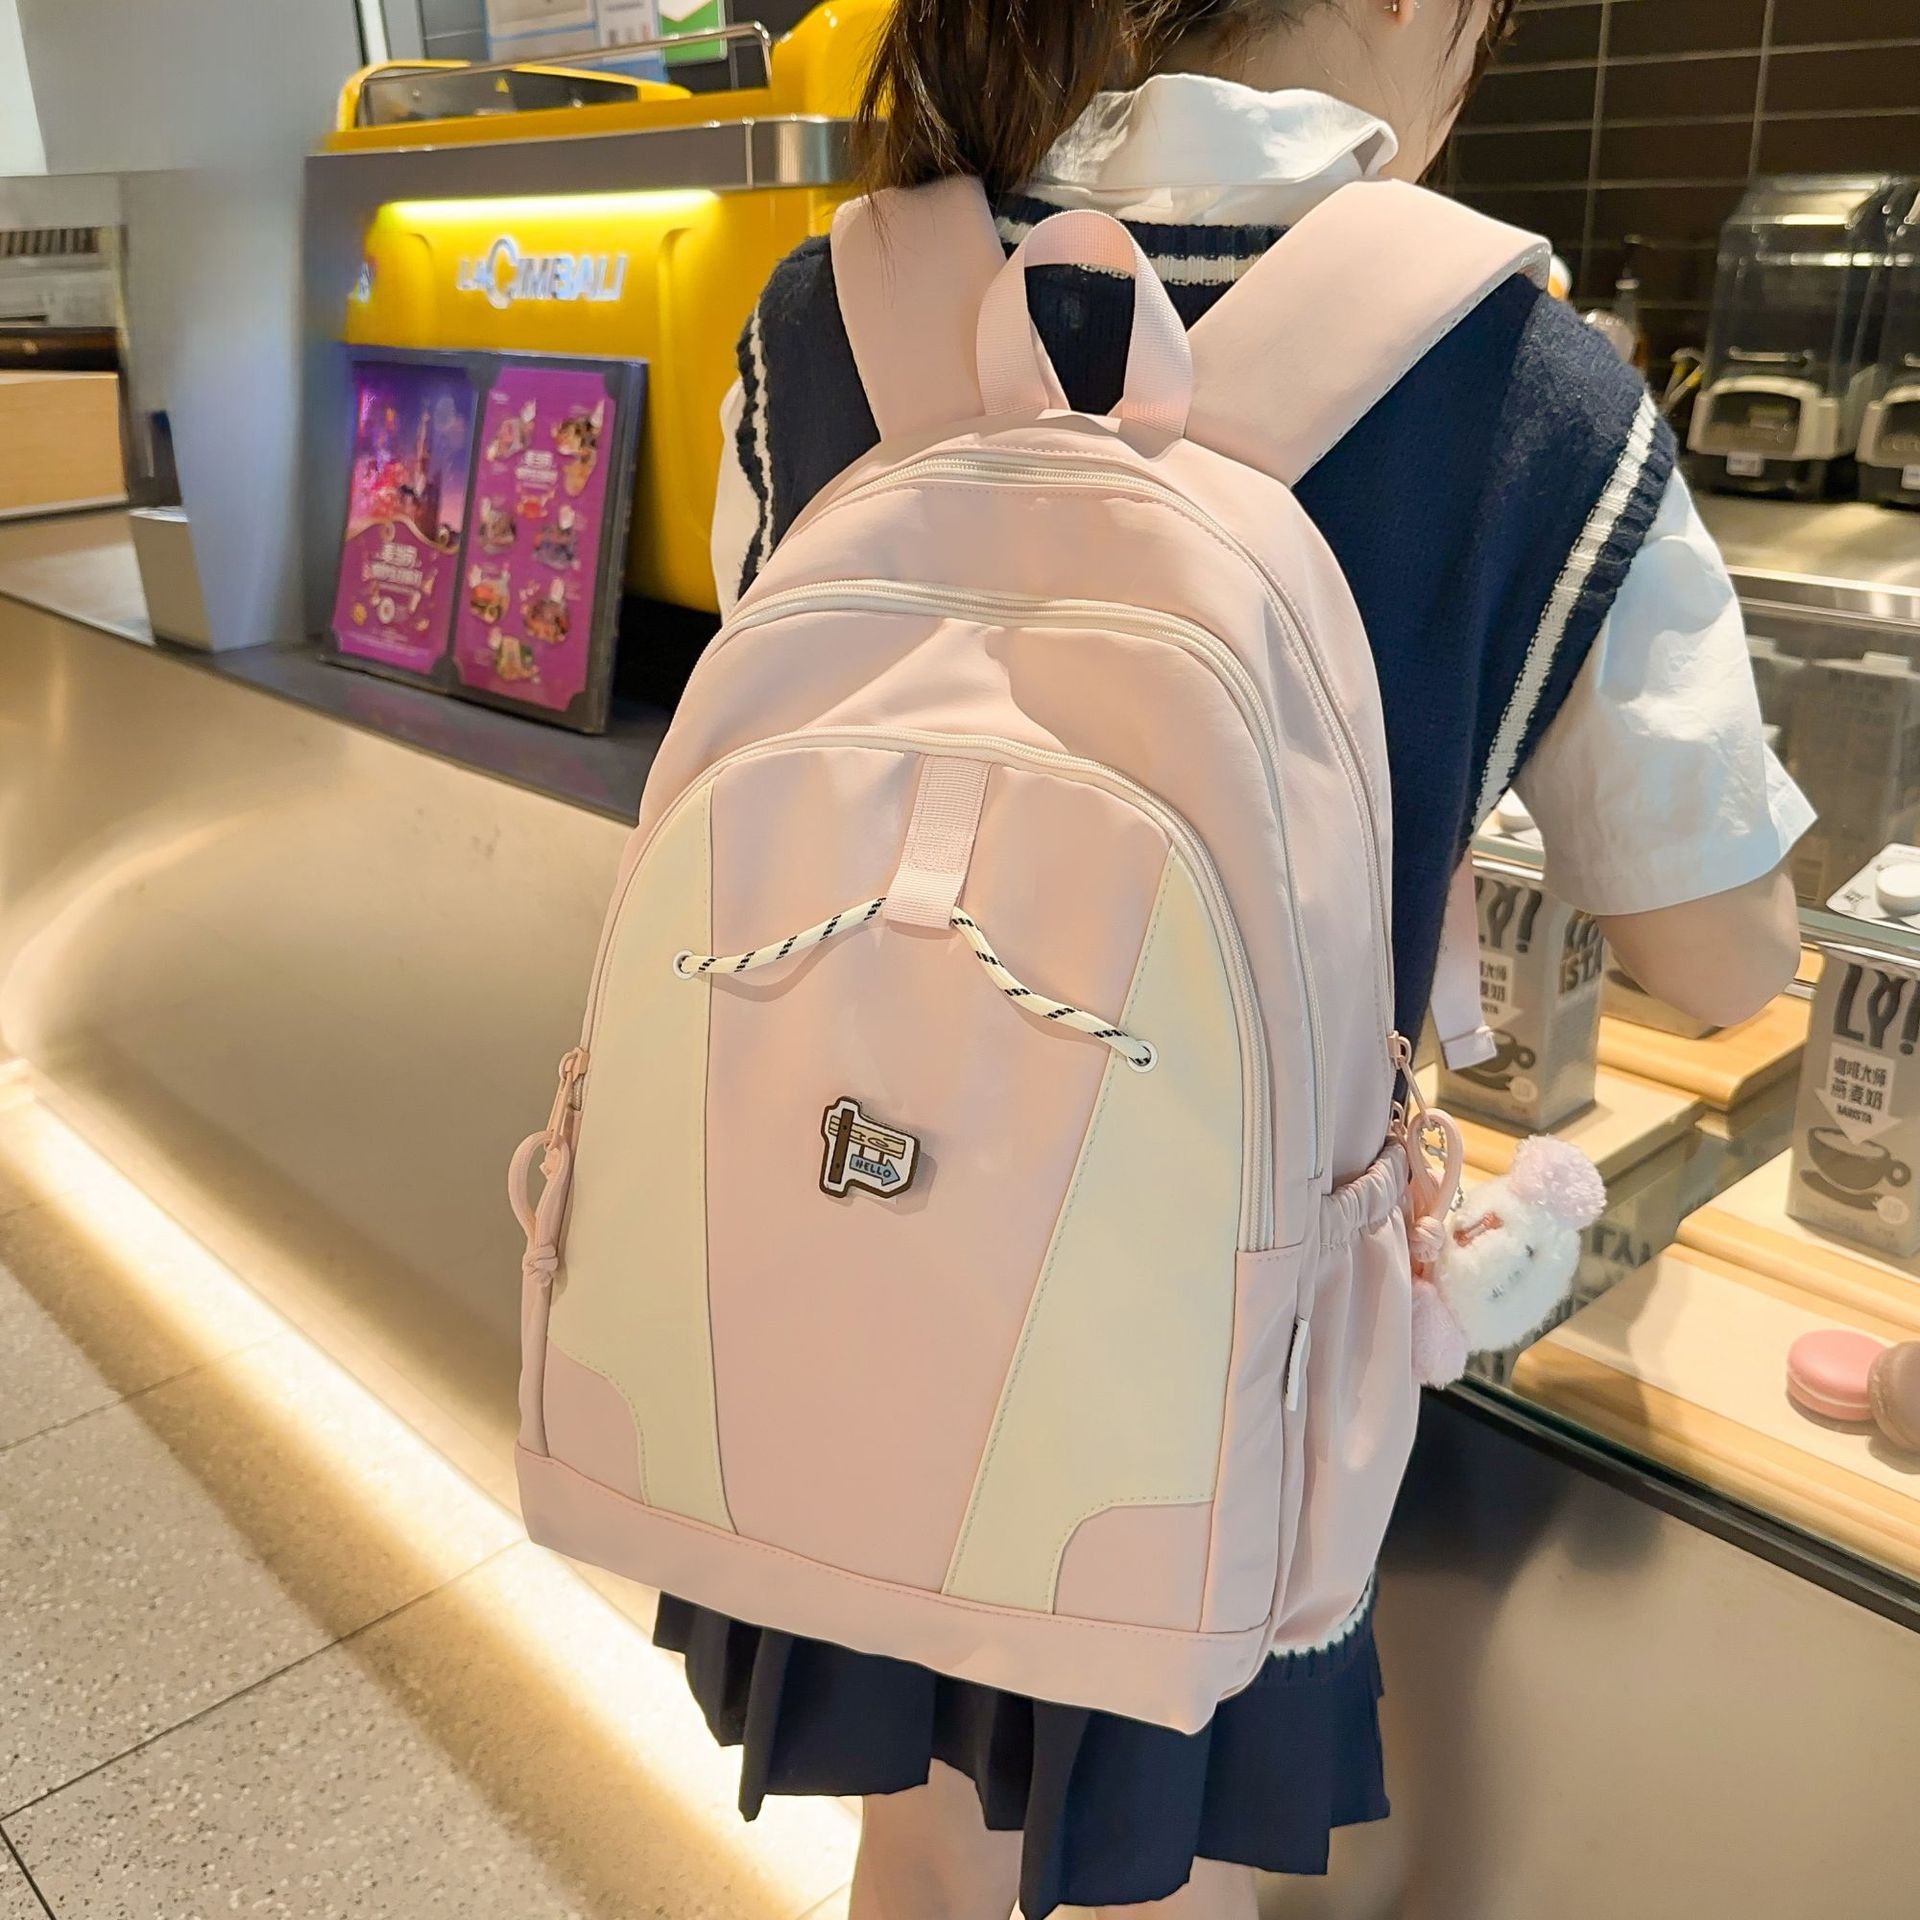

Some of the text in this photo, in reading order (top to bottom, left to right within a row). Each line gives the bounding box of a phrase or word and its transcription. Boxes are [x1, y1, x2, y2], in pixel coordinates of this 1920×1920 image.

[1833, 963, 1920, 1055] LY!
[1834, 1056, 1887, 1087] 咖啡大师
[1830, 1077, 1883, 1110] 燕麦奶
[855, 1159, 892, 1178] HELLO
